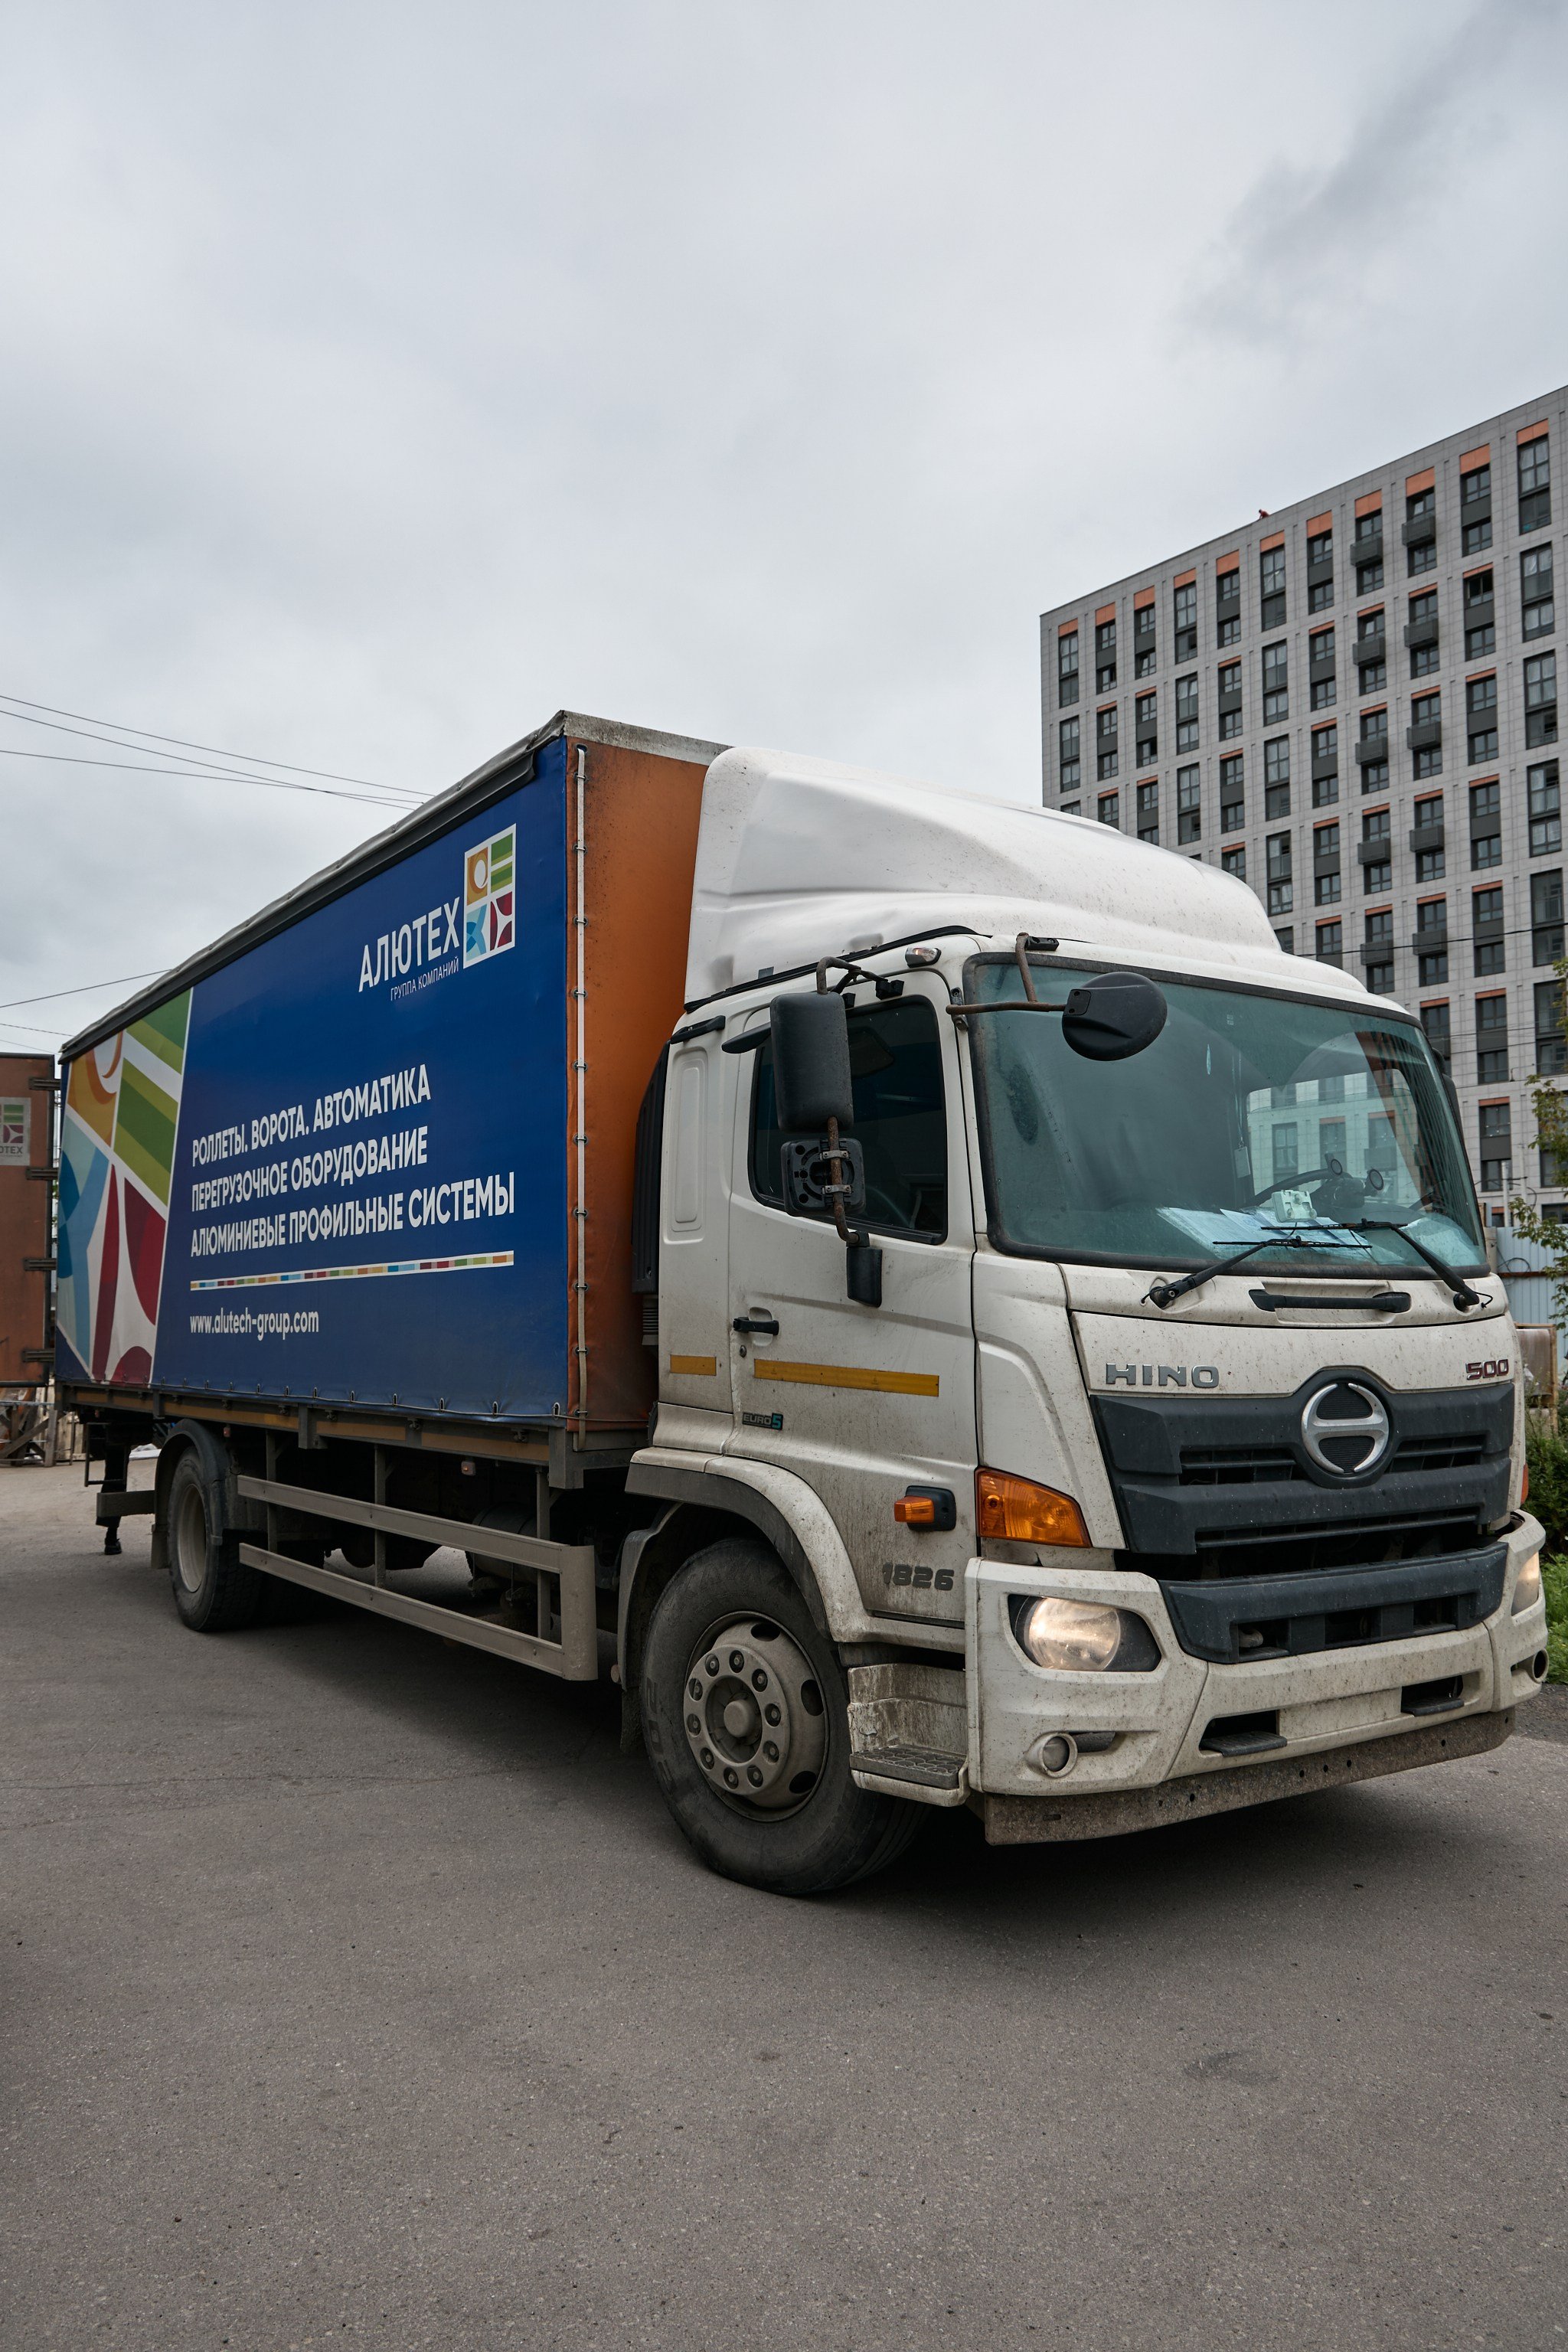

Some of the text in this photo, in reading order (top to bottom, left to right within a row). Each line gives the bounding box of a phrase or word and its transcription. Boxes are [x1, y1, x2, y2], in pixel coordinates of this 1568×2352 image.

[359, 896, 461, 993] АЛЮТЕХ
[390, 956, 459, 1001] ГРУППА КОМПАНИЙ
[192, 1063, 431, 1168] РОЛЛЕТЫ. ВОРОТА. АВТОМАТИКА
[191, 1125, 428, 1212] ПЕРЕГРУЗОЧНОЕ ОБОРУДОВАНИЕ
[191, 1171, 514, 1257] АЛЮМИНИЕВЫЕ ПРОФИЛЬНЫЕ СИСТЕМЫ
[190, 1308, 319, 1341] www.alutech-group.com
[1106, 1363, 1220, 1389] HINO
[1465, 1359, 1509, 1380] 500
[883, 1563, 955, 1591] 1826
